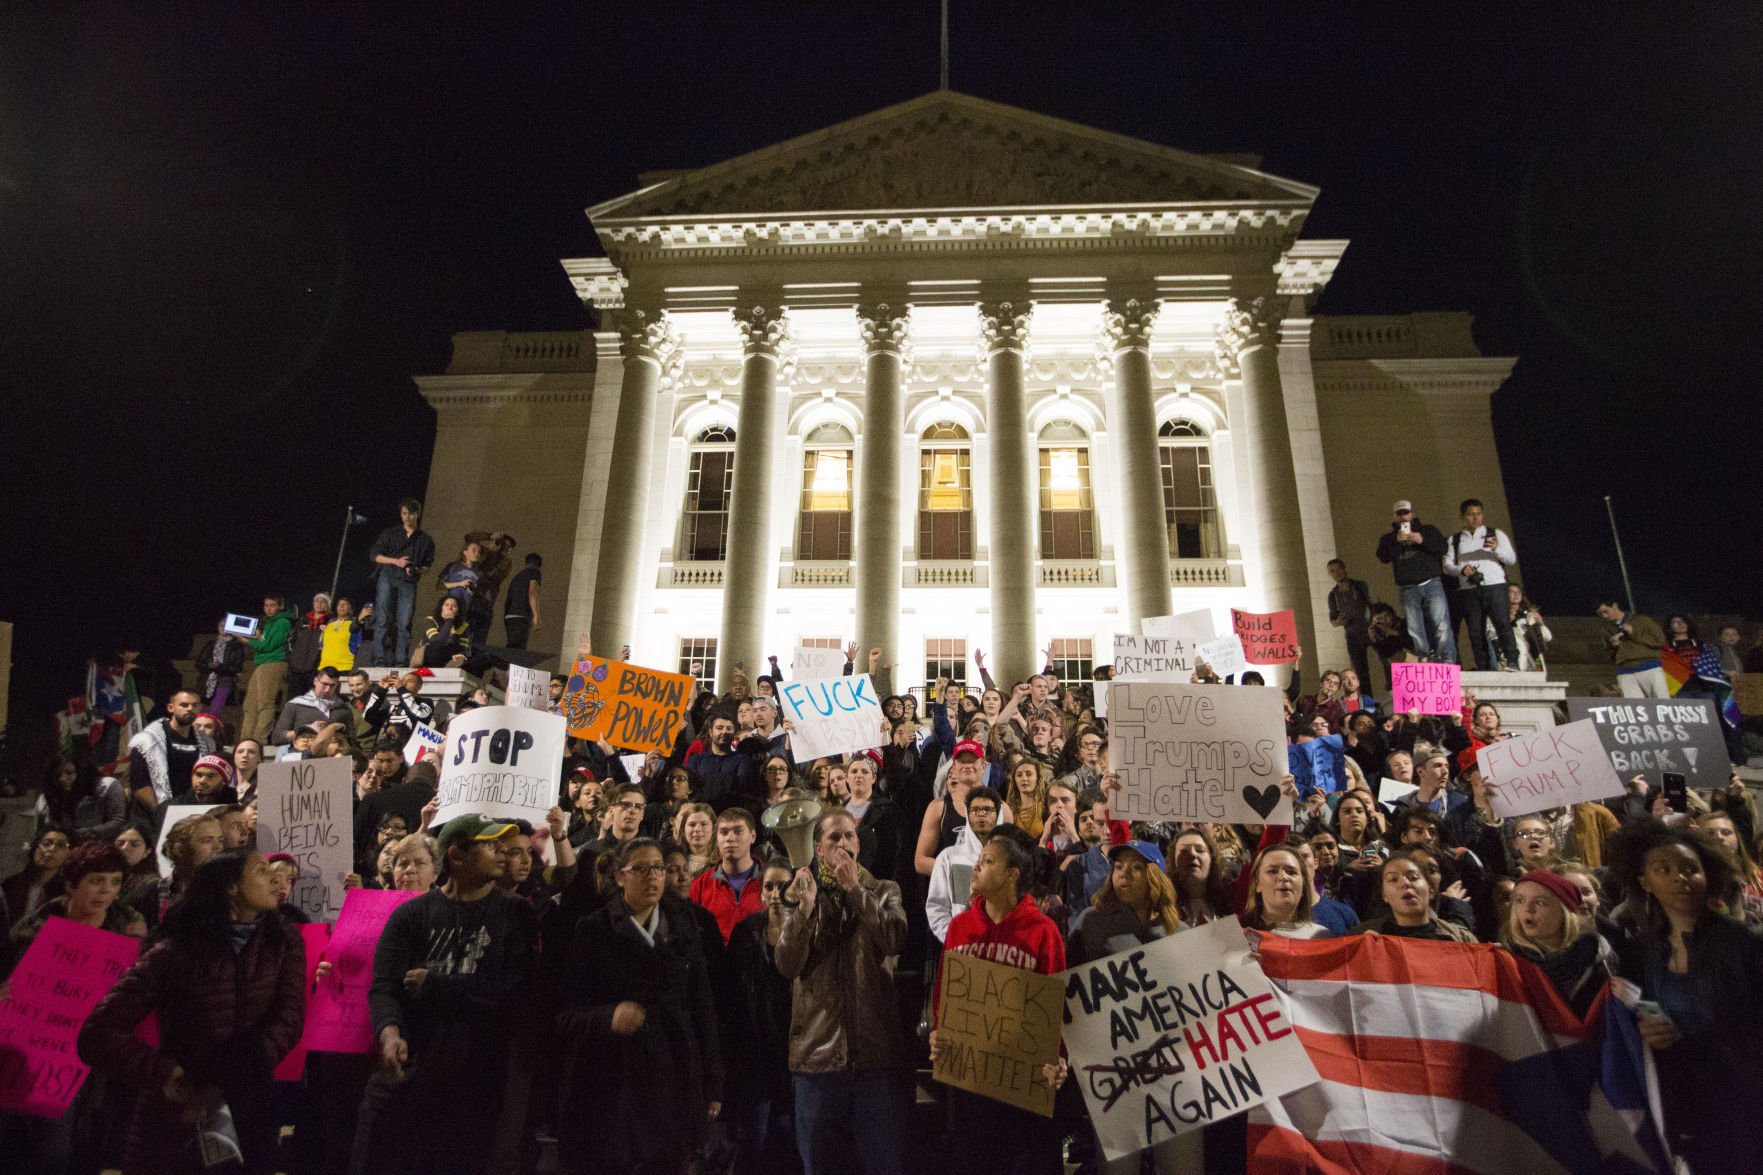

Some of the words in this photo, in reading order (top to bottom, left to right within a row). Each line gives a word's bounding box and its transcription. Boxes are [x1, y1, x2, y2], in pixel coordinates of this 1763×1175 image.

[1234, 611, 1273, 630] Build
[1144, 638, 1168, 655] NOT
[1174, 640, 1184, 655] A
[1236, 631, 1287, 644] RIDGES
[527, 669, 536, 680] TO
[797, 652, 826, 669] NO
[1114, 655, 1192, 676] CRIMINAL
[1400, 665, 1452, 680] THINK
[617, 669, 684, 708] BROWN
[783, 678, 877, 721] FUCK
[1402, 696, 1427, 712] MY
[1435, 696, 1456, 712] BOX
[1406, 680, 1436, 693] OUT
[1441, 680, 1454, 696] OF
[1114, 684, 1217, 727] Love
[1588, 705, 1648, 724] THIS
[1656, 705, 1709, 724] PUSSY
[453, 728, 534, 767] STOP
[1613, 724, 1690, 745] GRABS
[1114, 725, 1275, 792] Trumps
[1486, 731, 1583, 777] FUCK
[1611, 748, 1677, 771] BACK
[291, 764, 315, 792] NO
[1115, 768, 1225, 818] Hate
[1496, 760, 1581, 806] TRUMP
[281, 790, 331, 826] HUMAN
[278, 823, 339, 851] BEING
[51, 943, 92, 966] THEY
[27, 972, 45, 989] TO
[52, 979, 92, 1001] BURY
[946, 957, 1050, 1027] BLACK
[1063, 951, 1157, 1025] MAKE
[1110, 970, 1248, 1050] AMERICA
[942, 1003, 1039, 1055] LIVES
[1183, 993, 1292, 1070] HATE
[940, 1040, 1049, 1108] MATTER
[1145, 1057, 1262, 1144] AGAIN
